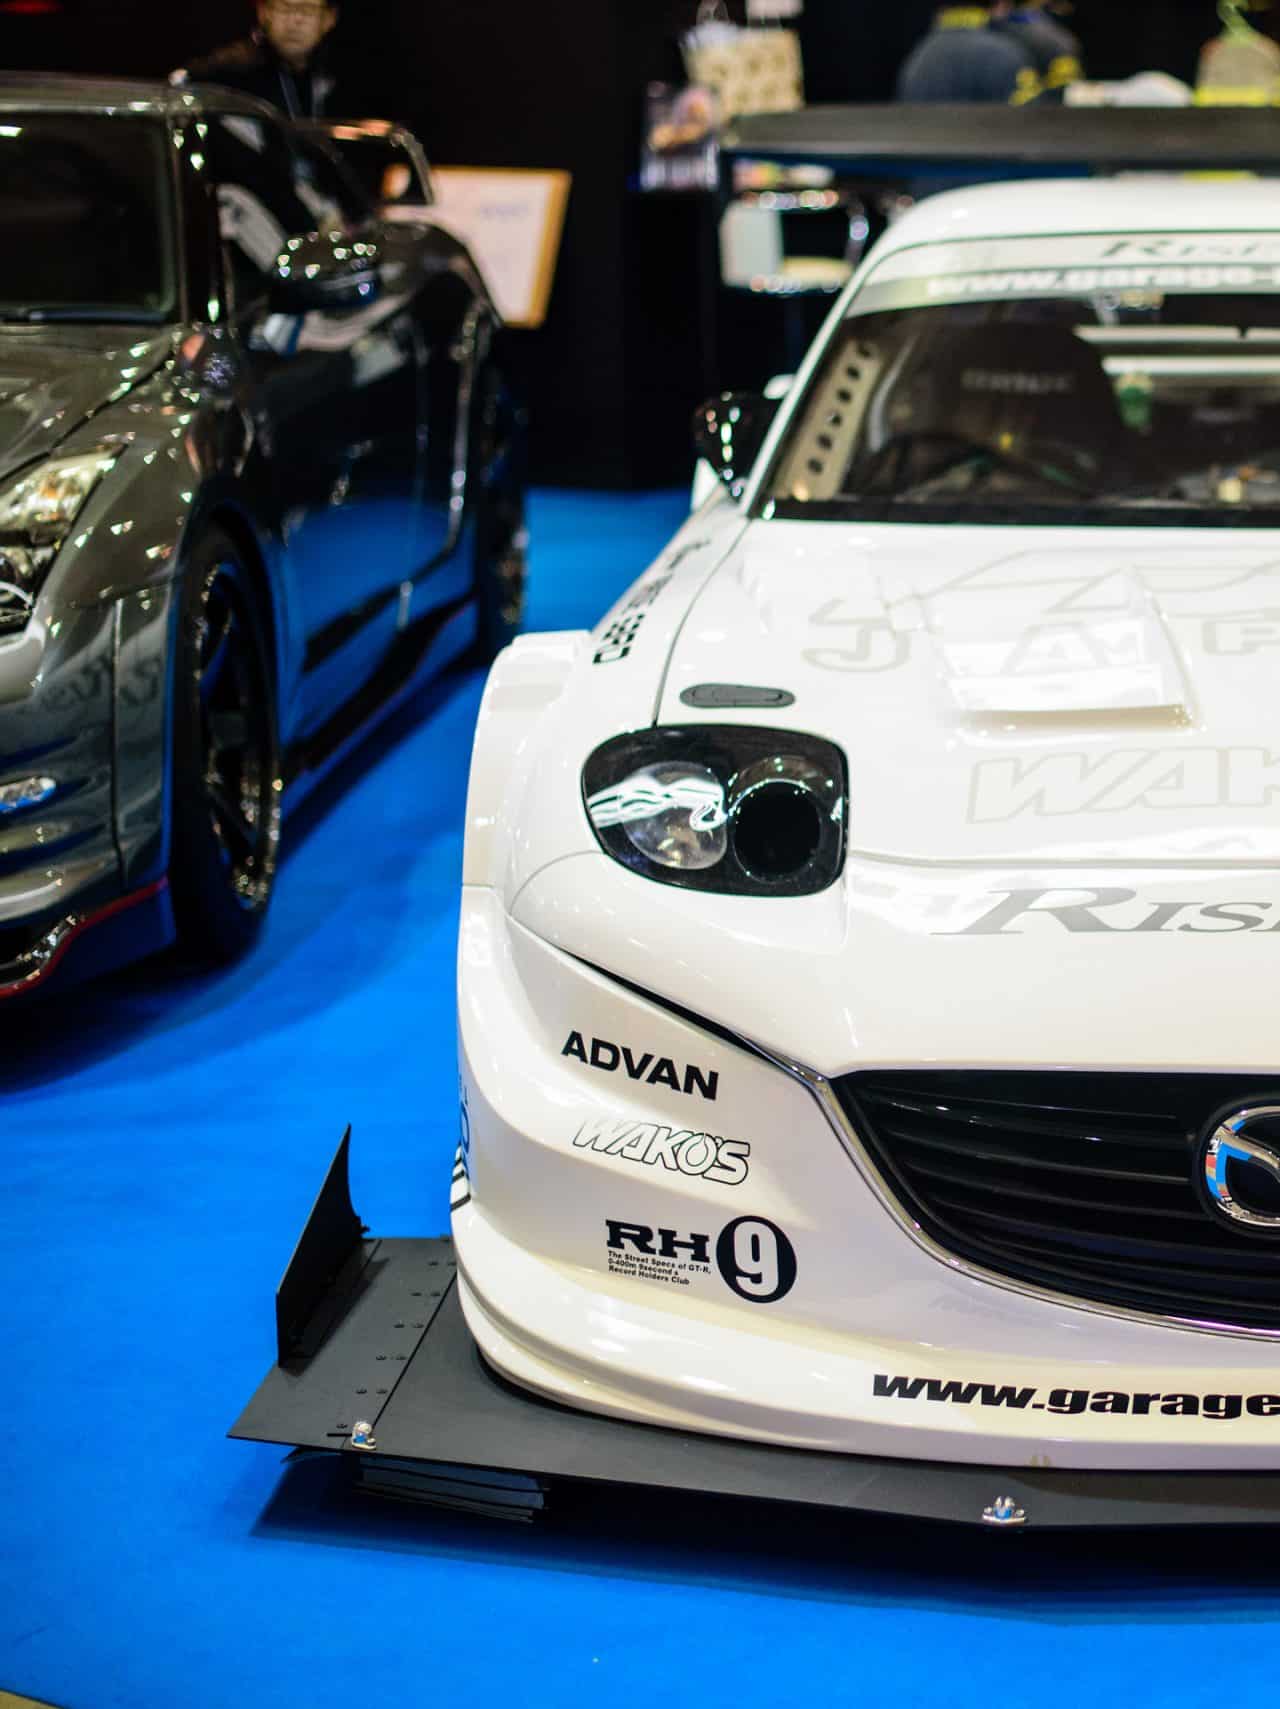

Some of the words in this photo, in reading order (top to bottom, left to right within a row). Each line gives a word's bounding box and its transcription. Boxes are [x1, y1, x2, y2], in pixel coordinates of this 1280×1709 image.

[560, 1030, 719, 1101] ADVAN
[608, 1251, 623, 1260] The
[625, 1253, 649, 1264] Street
[608, 1265, 637, 1277] Record
[638, 1270, 669, 1282] Holders
